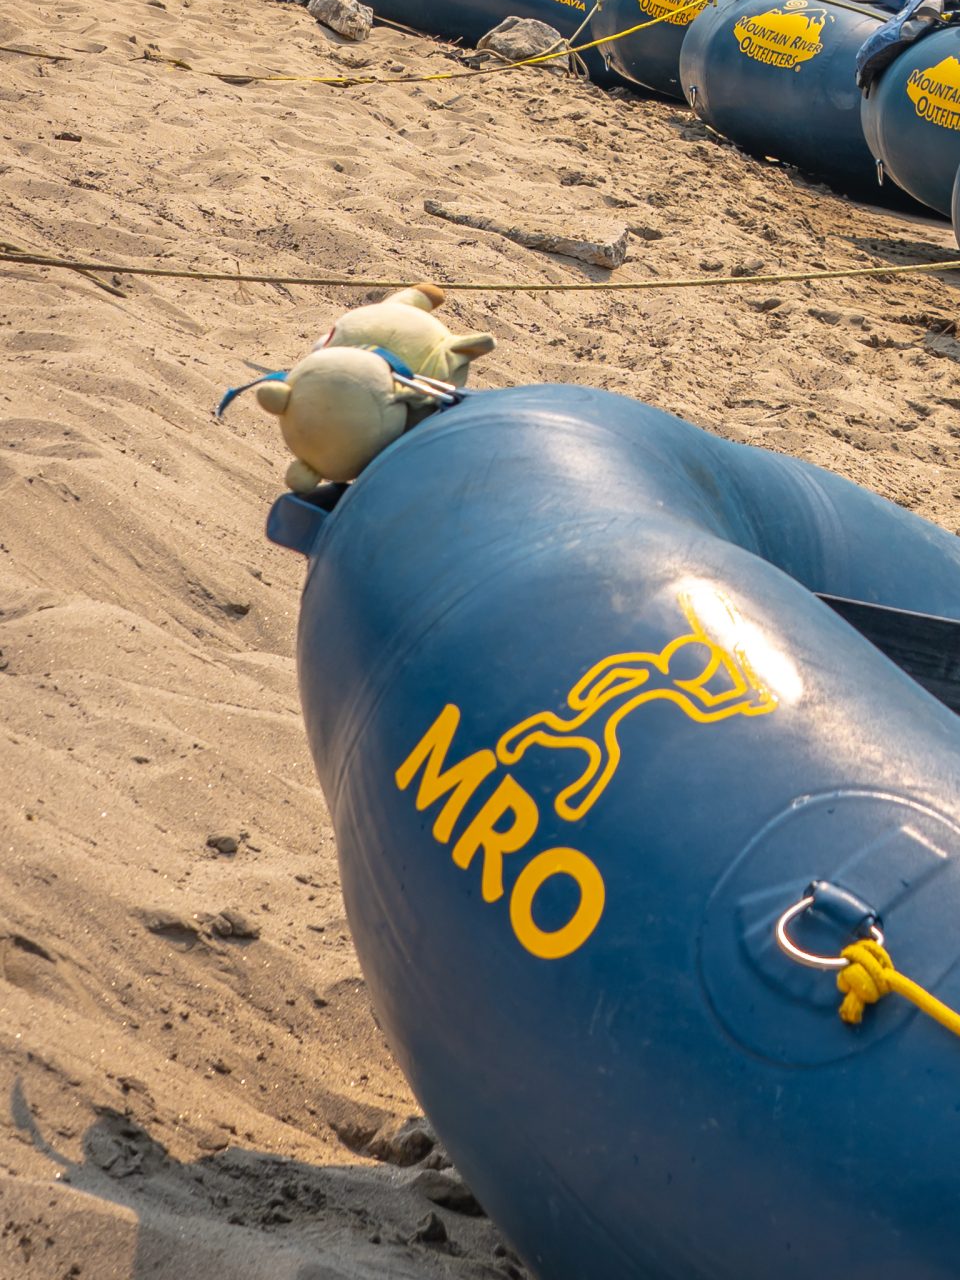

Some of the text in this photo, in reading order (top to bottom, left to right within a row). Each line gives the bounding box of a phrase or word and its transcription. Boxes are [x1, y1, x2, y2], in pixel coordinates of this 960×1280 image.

[736, 17, 822, 53] MOUNTAIN RIVER
[741, 36, 798, 66] OUTFITTERS
[395, 703, 606, 960] MRO
